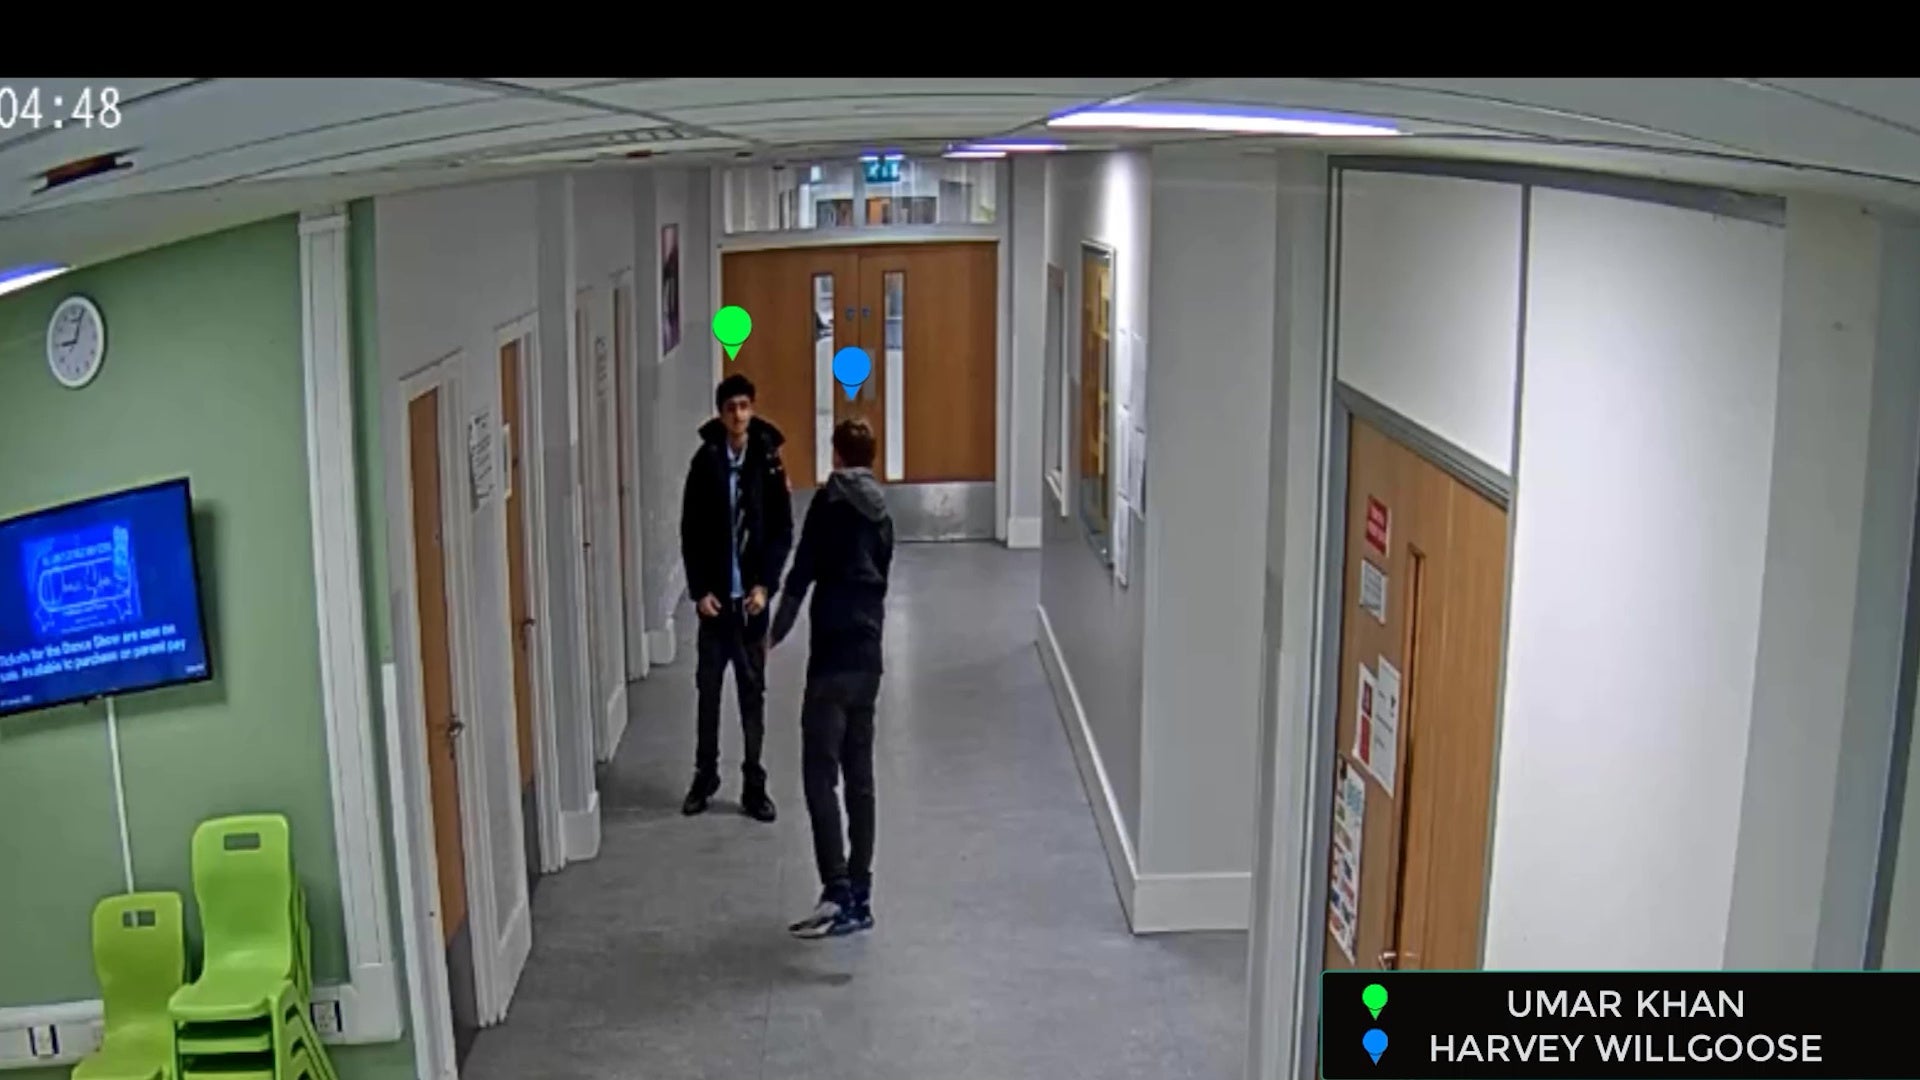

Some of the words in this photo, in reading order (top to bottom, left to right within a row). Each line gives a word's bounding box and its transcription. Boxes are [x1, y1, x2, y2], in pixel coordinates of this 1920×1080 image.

[31, 648, 44, 660] for
[45, 644, 61, 658] the
[62, 640, 92, 655] Dance
[93, 634, 120, 649] Show
[122, 631, 138, 643] are
[140, 627, 161, 640] now
[162, 623, 176, 636] on
[63, 658, 73, 670] to
[75, 651, 119, 671] purchase
[132, 640, 166, 658] parent
[166, 638, 186, 652] pay
